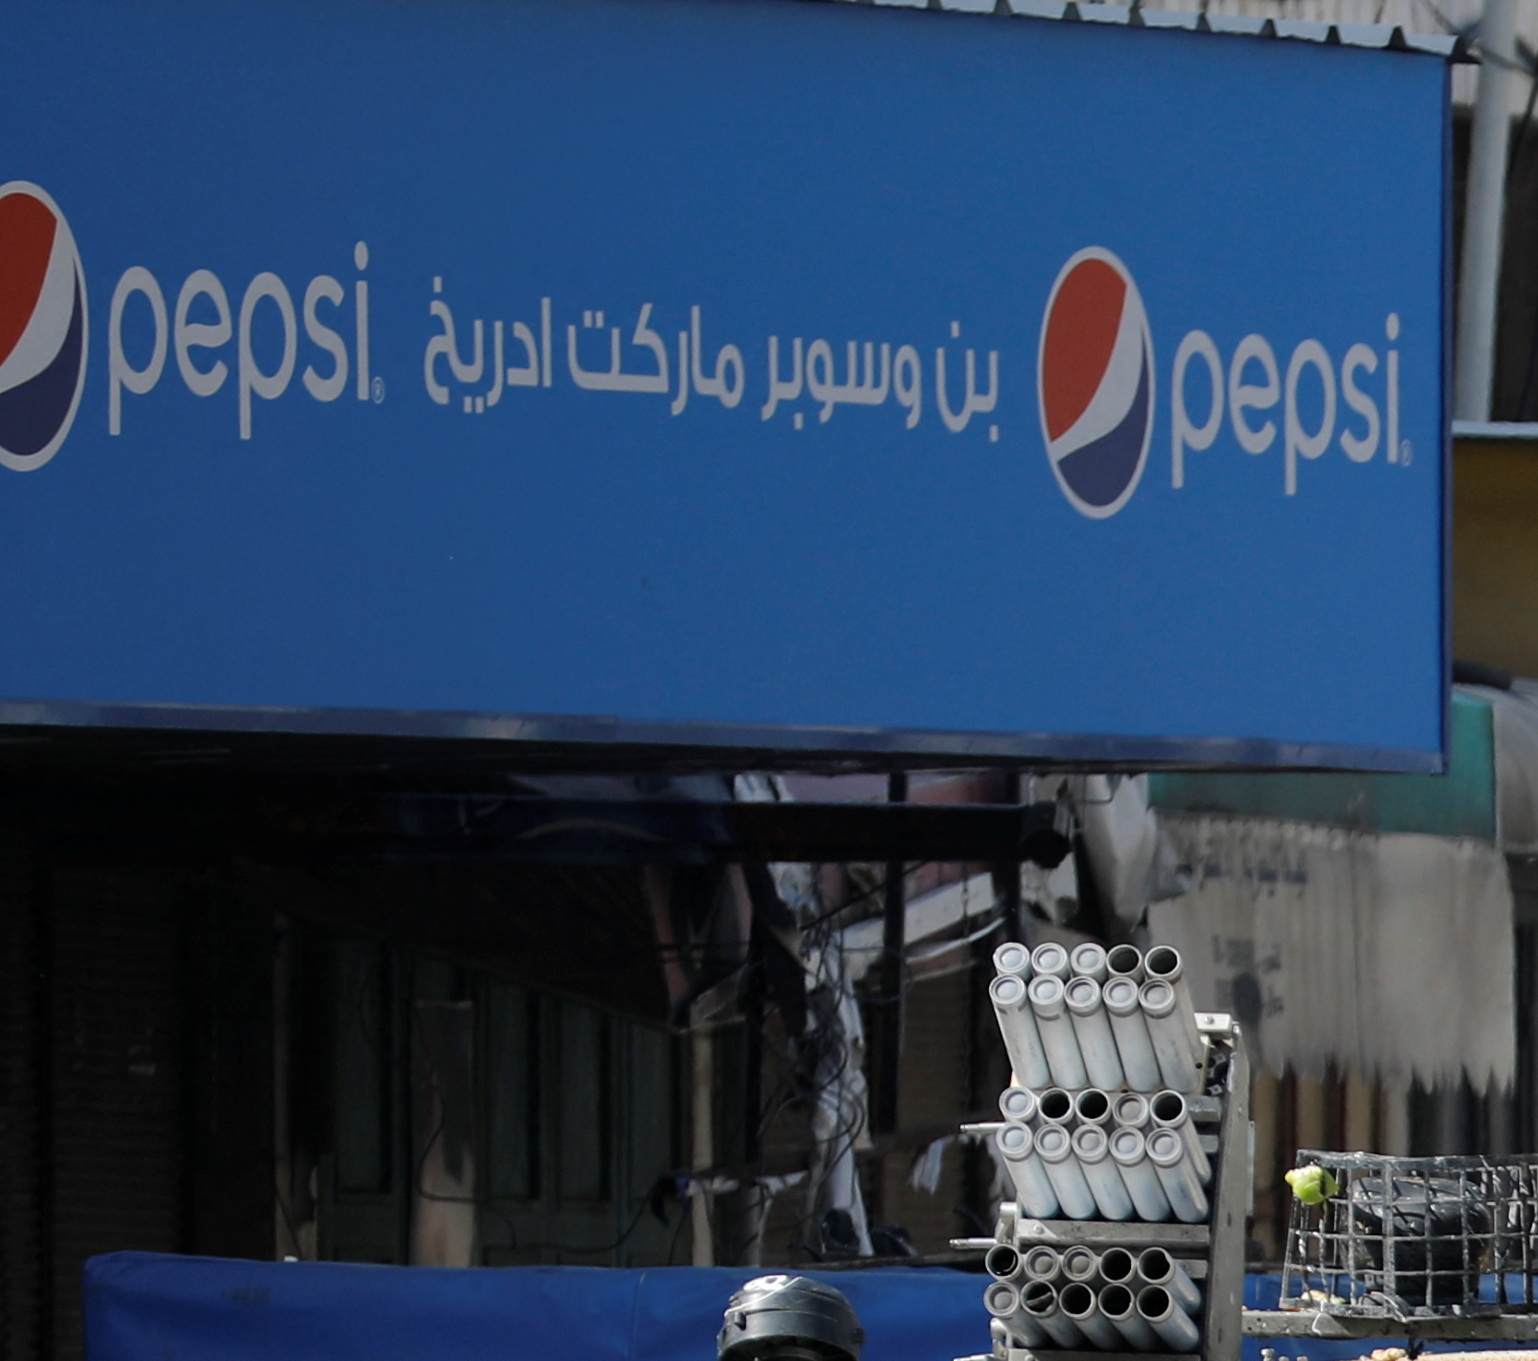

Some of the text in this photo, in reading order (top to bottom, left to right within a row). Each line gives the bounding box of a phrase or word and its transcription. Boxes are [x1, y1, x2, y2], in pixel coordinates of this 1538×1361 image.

[109, 241, 369, 440] pepsi
[566, 302, 746, 417] ماركت
[760, 334, 924, 431] وسوبر
[935, 320, 1000, 443] بن
[1170, 312, 1401, 496] pepsi
